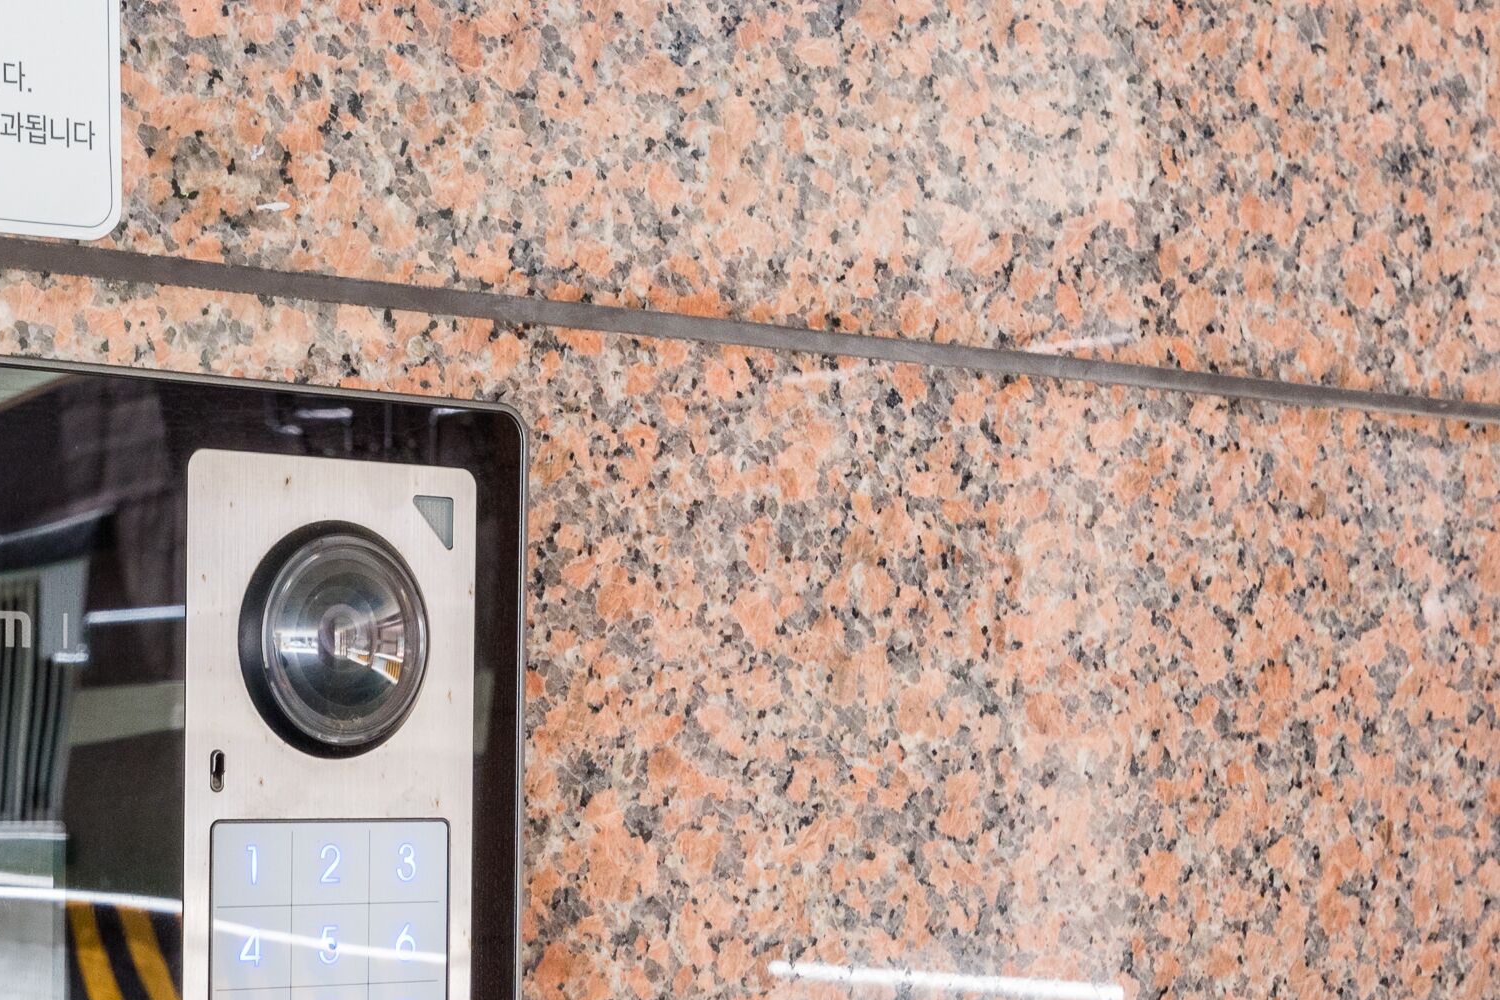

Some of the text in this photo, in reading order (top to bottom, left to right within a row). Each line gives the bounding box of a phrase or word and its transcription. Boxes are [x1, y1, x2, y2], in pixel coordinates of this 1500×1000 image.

[247, 843, 416, 884] 1 2 3
[239, 923, 416, 966] 4 5 6
